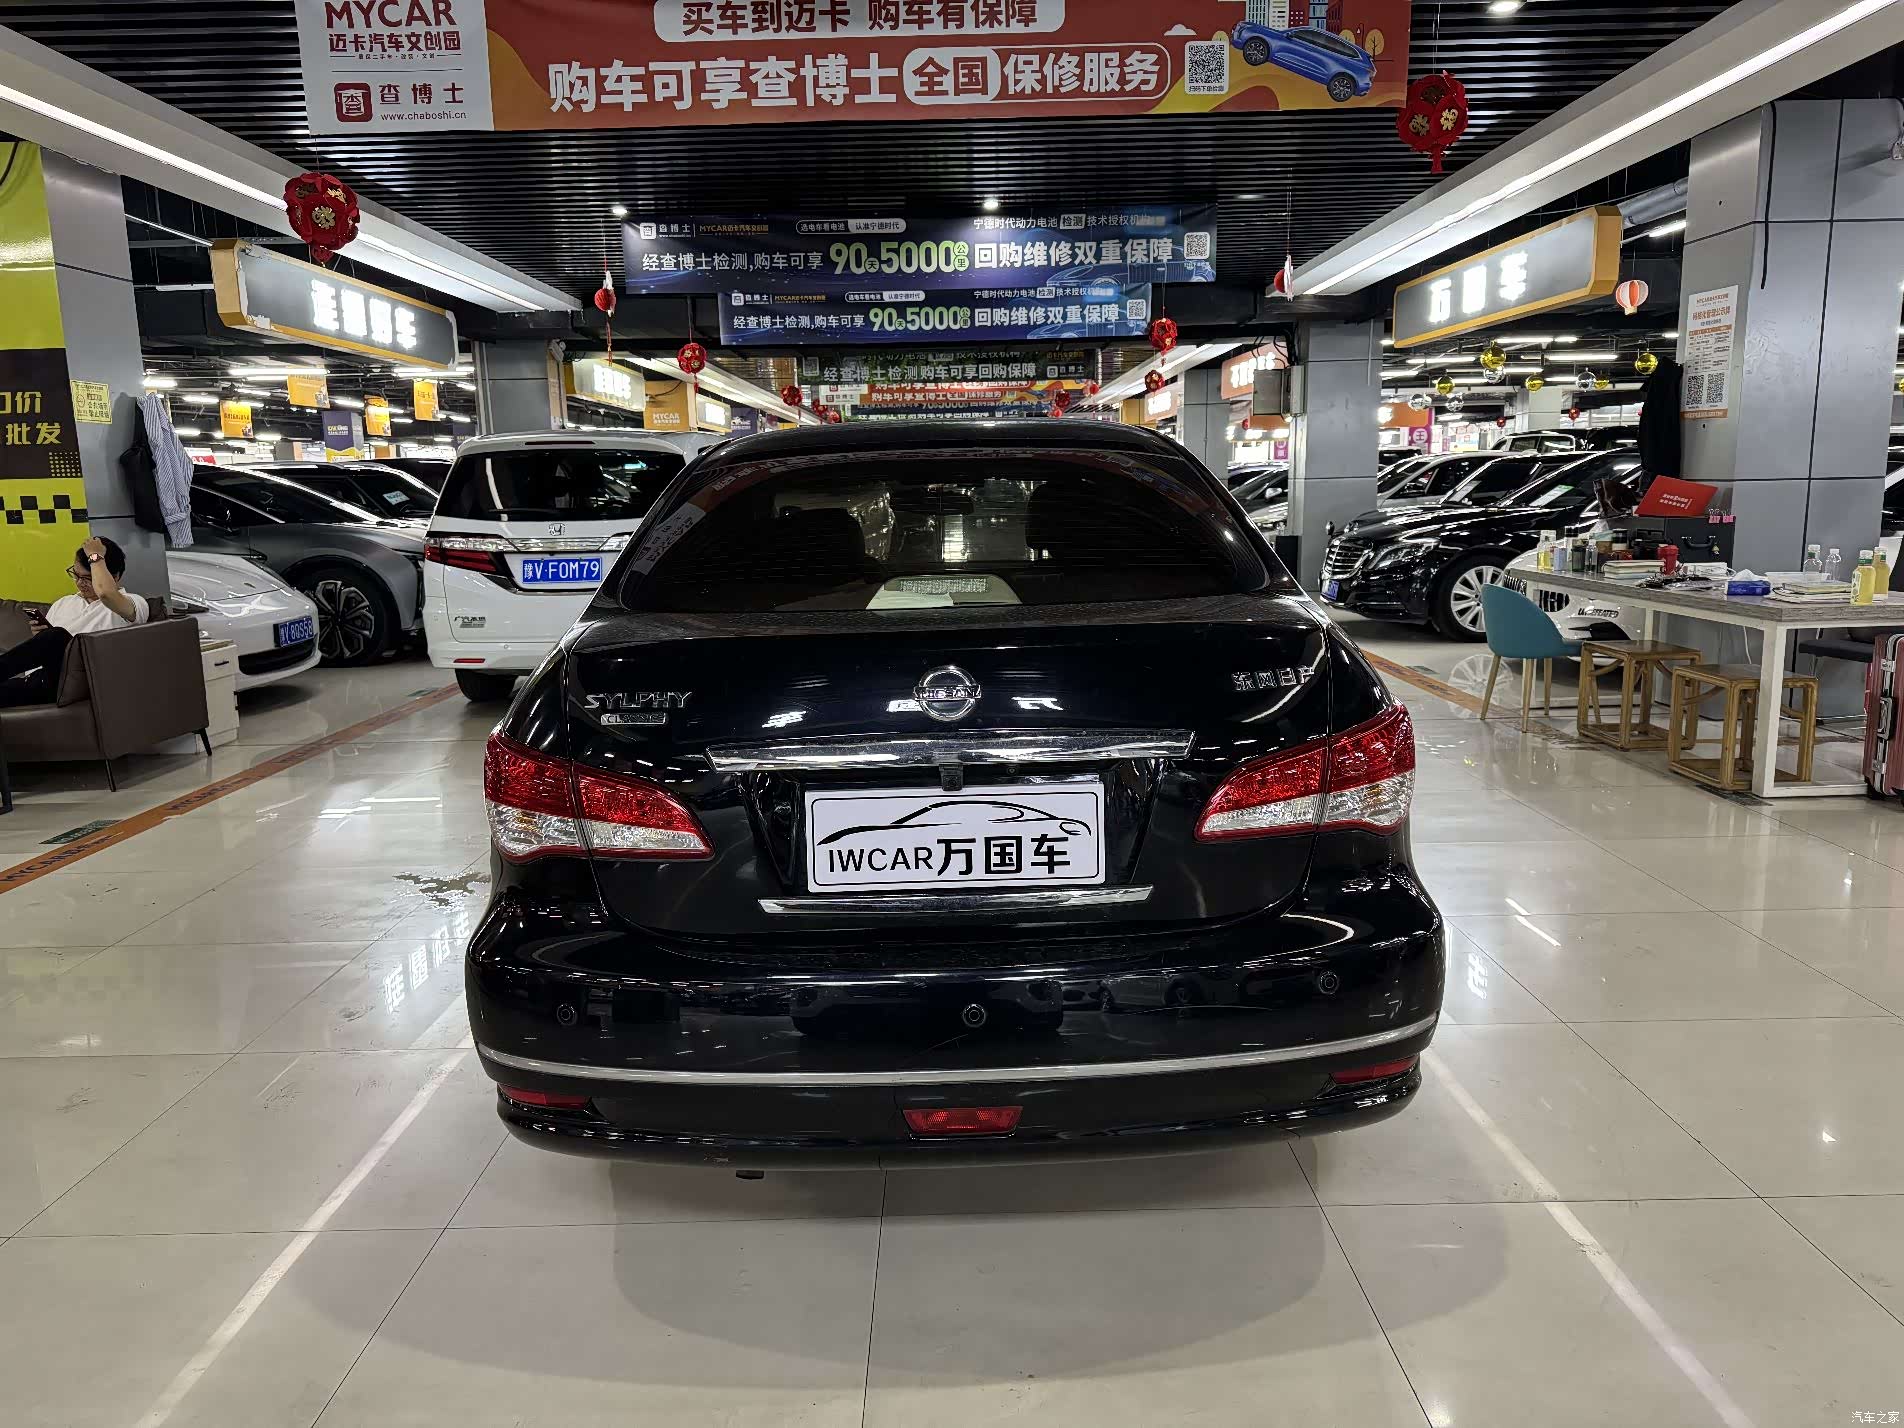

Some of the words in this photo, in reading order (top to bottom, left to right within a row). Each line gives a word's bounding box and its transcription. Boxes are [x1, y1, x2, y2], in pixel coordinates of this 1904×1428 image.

[325, 0, 457, 29] MYCAR
[682, 0, 850, 36] 买车到迈卡
[868, 0, 1038, 31] 购车有保障
[329, 31, 461, 52] 迈卡汽车文创园
[548, 53, 899, 112] 购车可享查博士
[911, 56, 989, 98] 全国
[1003, 49, 1162, 95] 保修服务
[378, 83, 464, 105] 查博士
[381, 111, 467, 121] www.chaboshi.cn
[973, 216, 1058, 230] 宁德时代动力电池
[974, 238, 1173, 269] 回购维修双重保障
[974, 303, 1120, 328] 回购维修双重保障
[6, 422, 62, 446] 批发
[584, 691, 693, 710] SYLPHY
